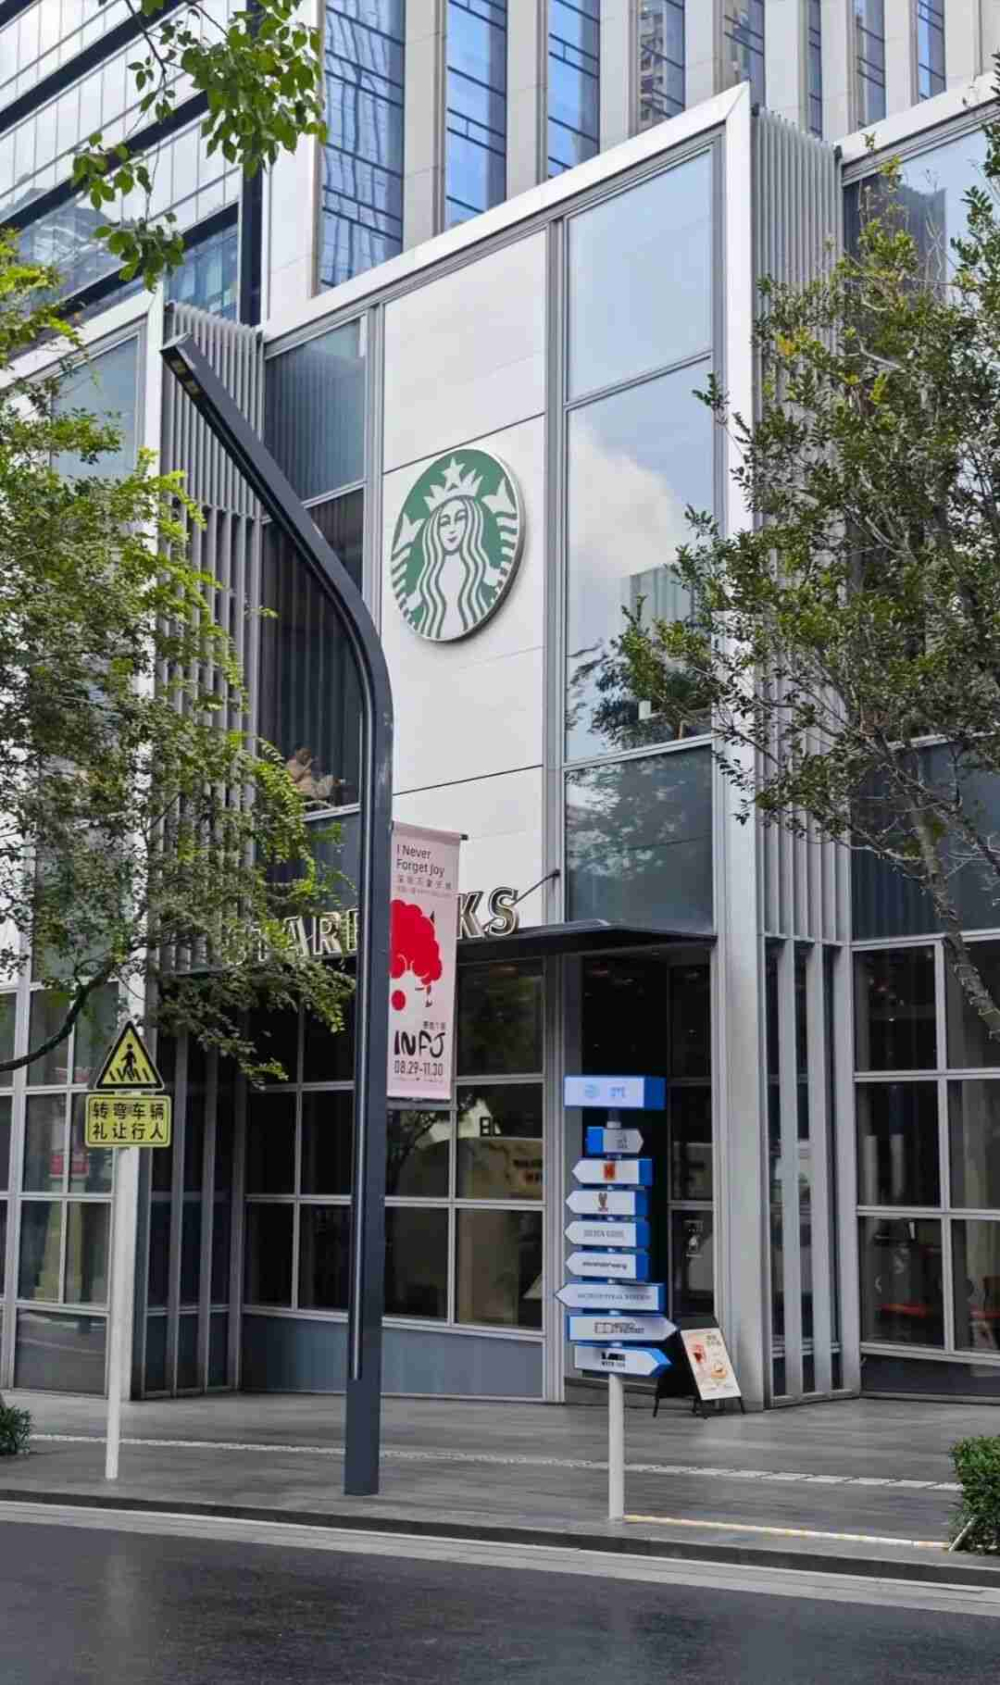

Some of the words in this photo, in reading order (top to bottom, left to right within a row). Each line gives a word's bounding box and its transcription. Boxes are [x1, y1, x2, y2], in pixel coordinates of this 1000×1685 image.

[402, 845, 431, 859] Never
[396, 859, 428, 874] Forget
[394, 1029, 446, 1058] INFJ
[92, 1101, 164, 1120] 转弯车辆
[92, 1122, 164, 1140] 礼让行人
